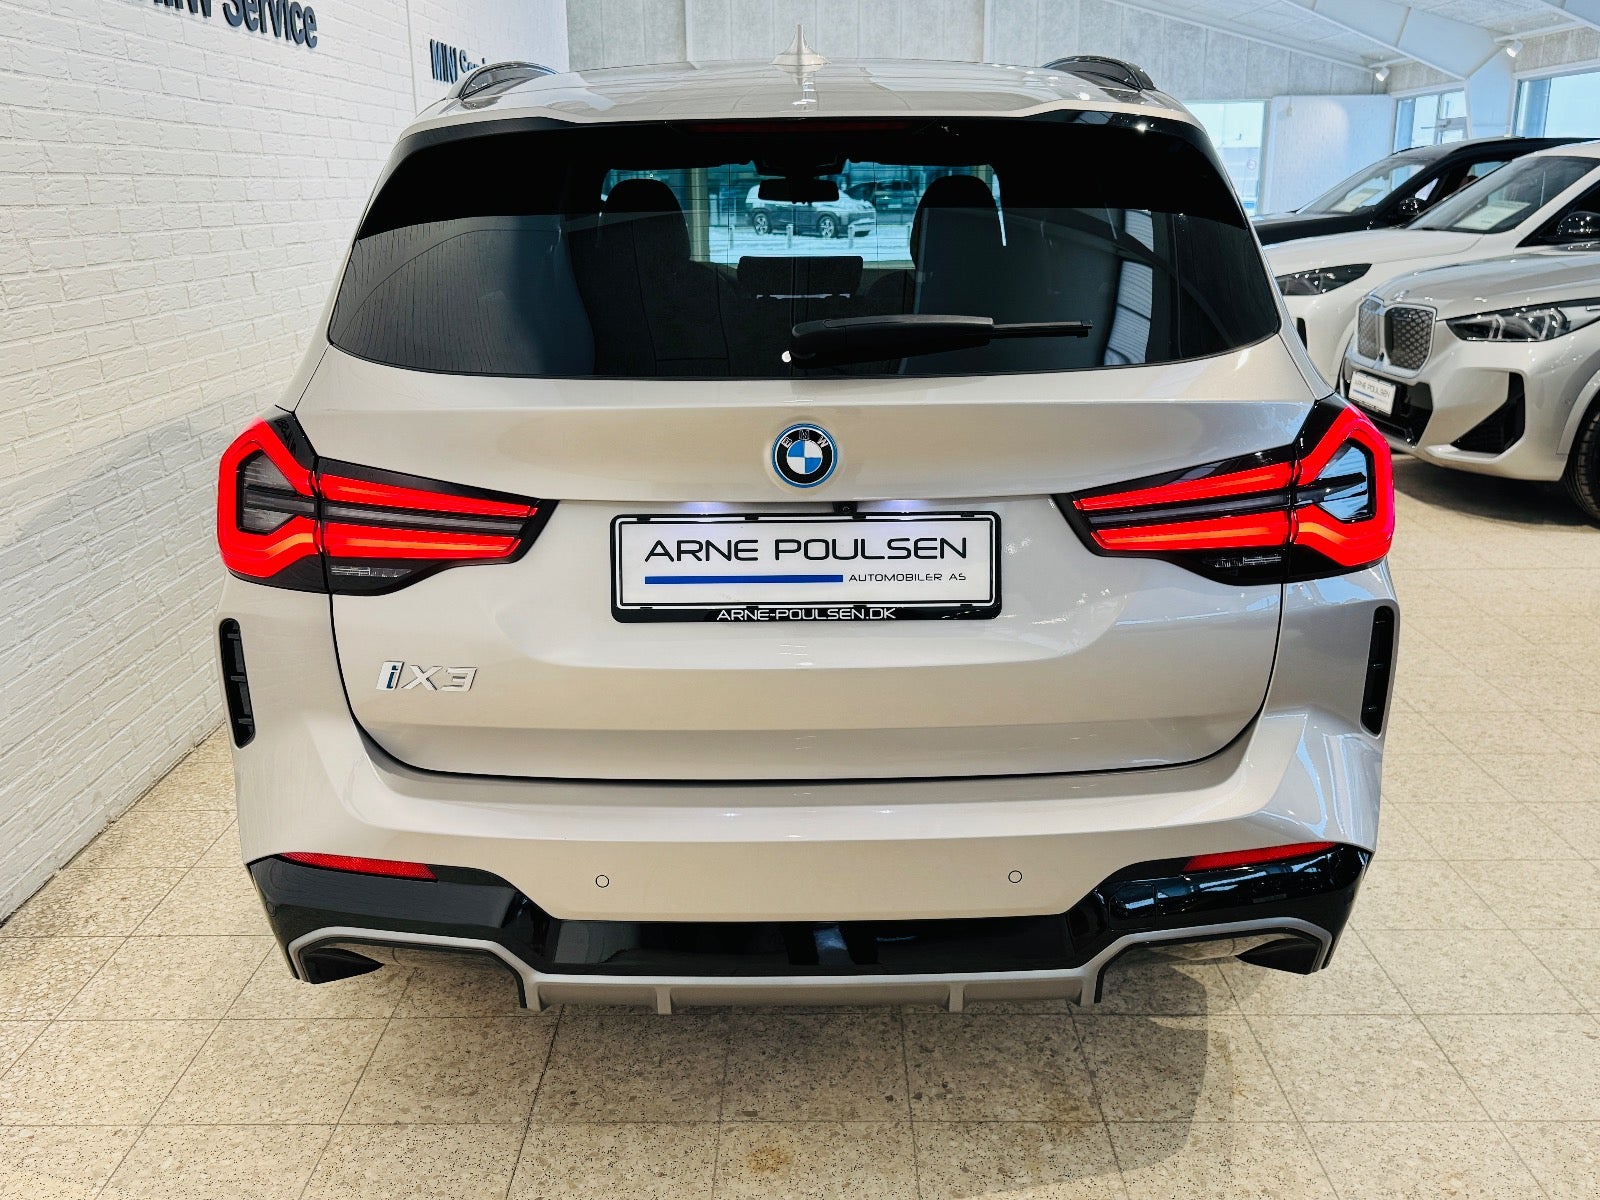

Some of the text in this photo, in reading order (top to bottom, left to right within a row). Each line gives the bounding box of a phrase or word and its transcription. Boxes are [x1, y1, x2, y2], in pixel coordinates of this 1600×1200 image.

[644, 537, 967, 562] ARNE POULSEN
[848, 572, 967, 582] AUTOMOBILER AS
[716, 608, 897, 621] ARNE-POULSEN.DK
